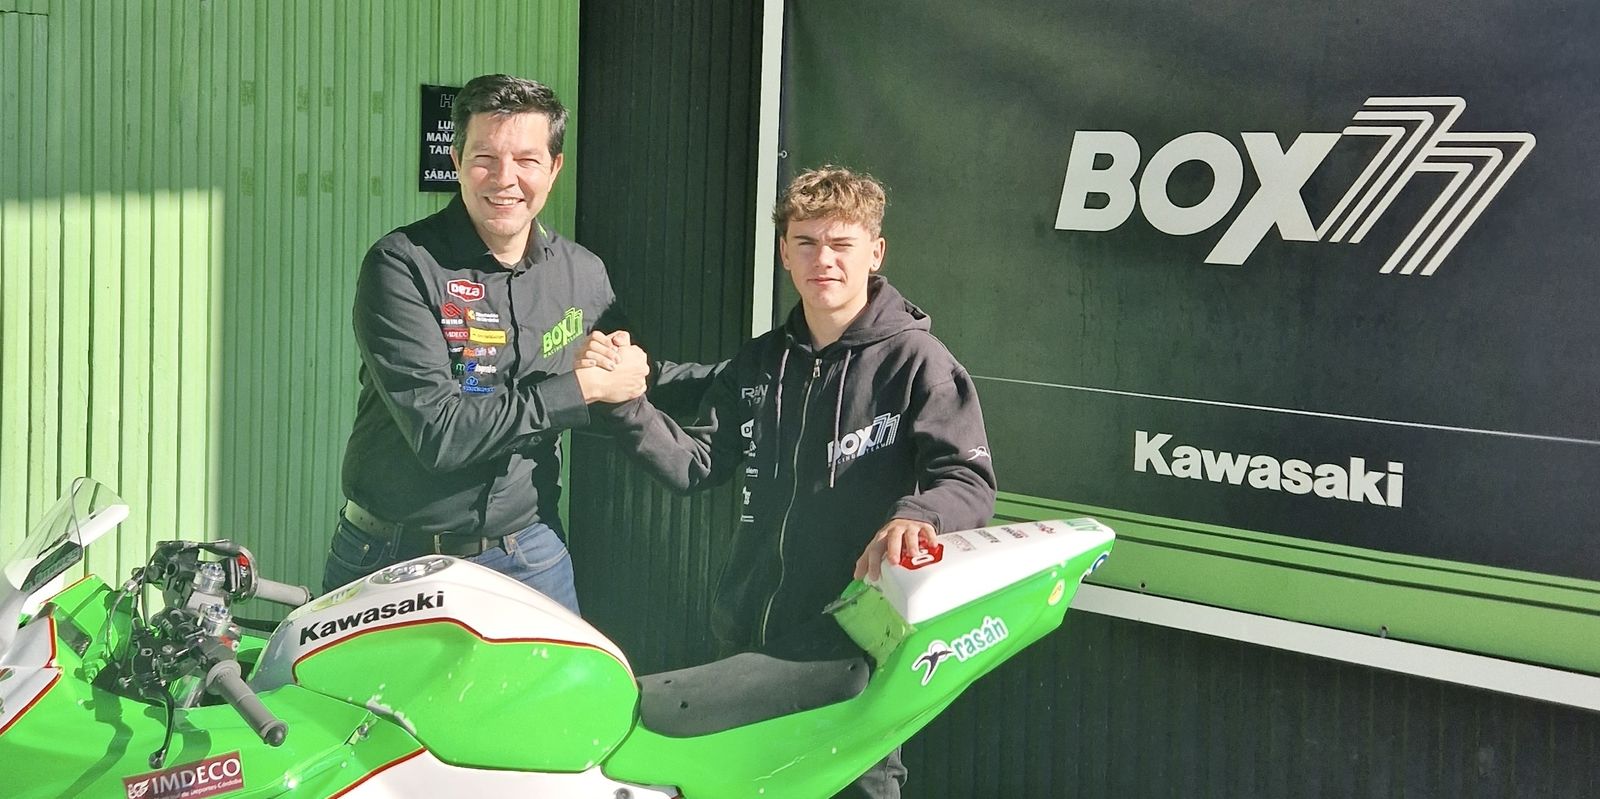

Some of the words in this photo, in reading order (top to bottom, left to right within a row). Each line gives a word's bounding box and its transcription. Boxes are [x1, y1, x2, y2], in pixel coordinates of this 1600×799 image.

[1054, 96, 1537, 276] BOX77
[543, 307, 583, 354] BOX77
[1133, 430, 1404, 508] Kawasaki
[300, 590, 445, 646] Kawasaki
[954, 618, 1006, 659] rasán
[151, 758, 241, 795] IMDECO
